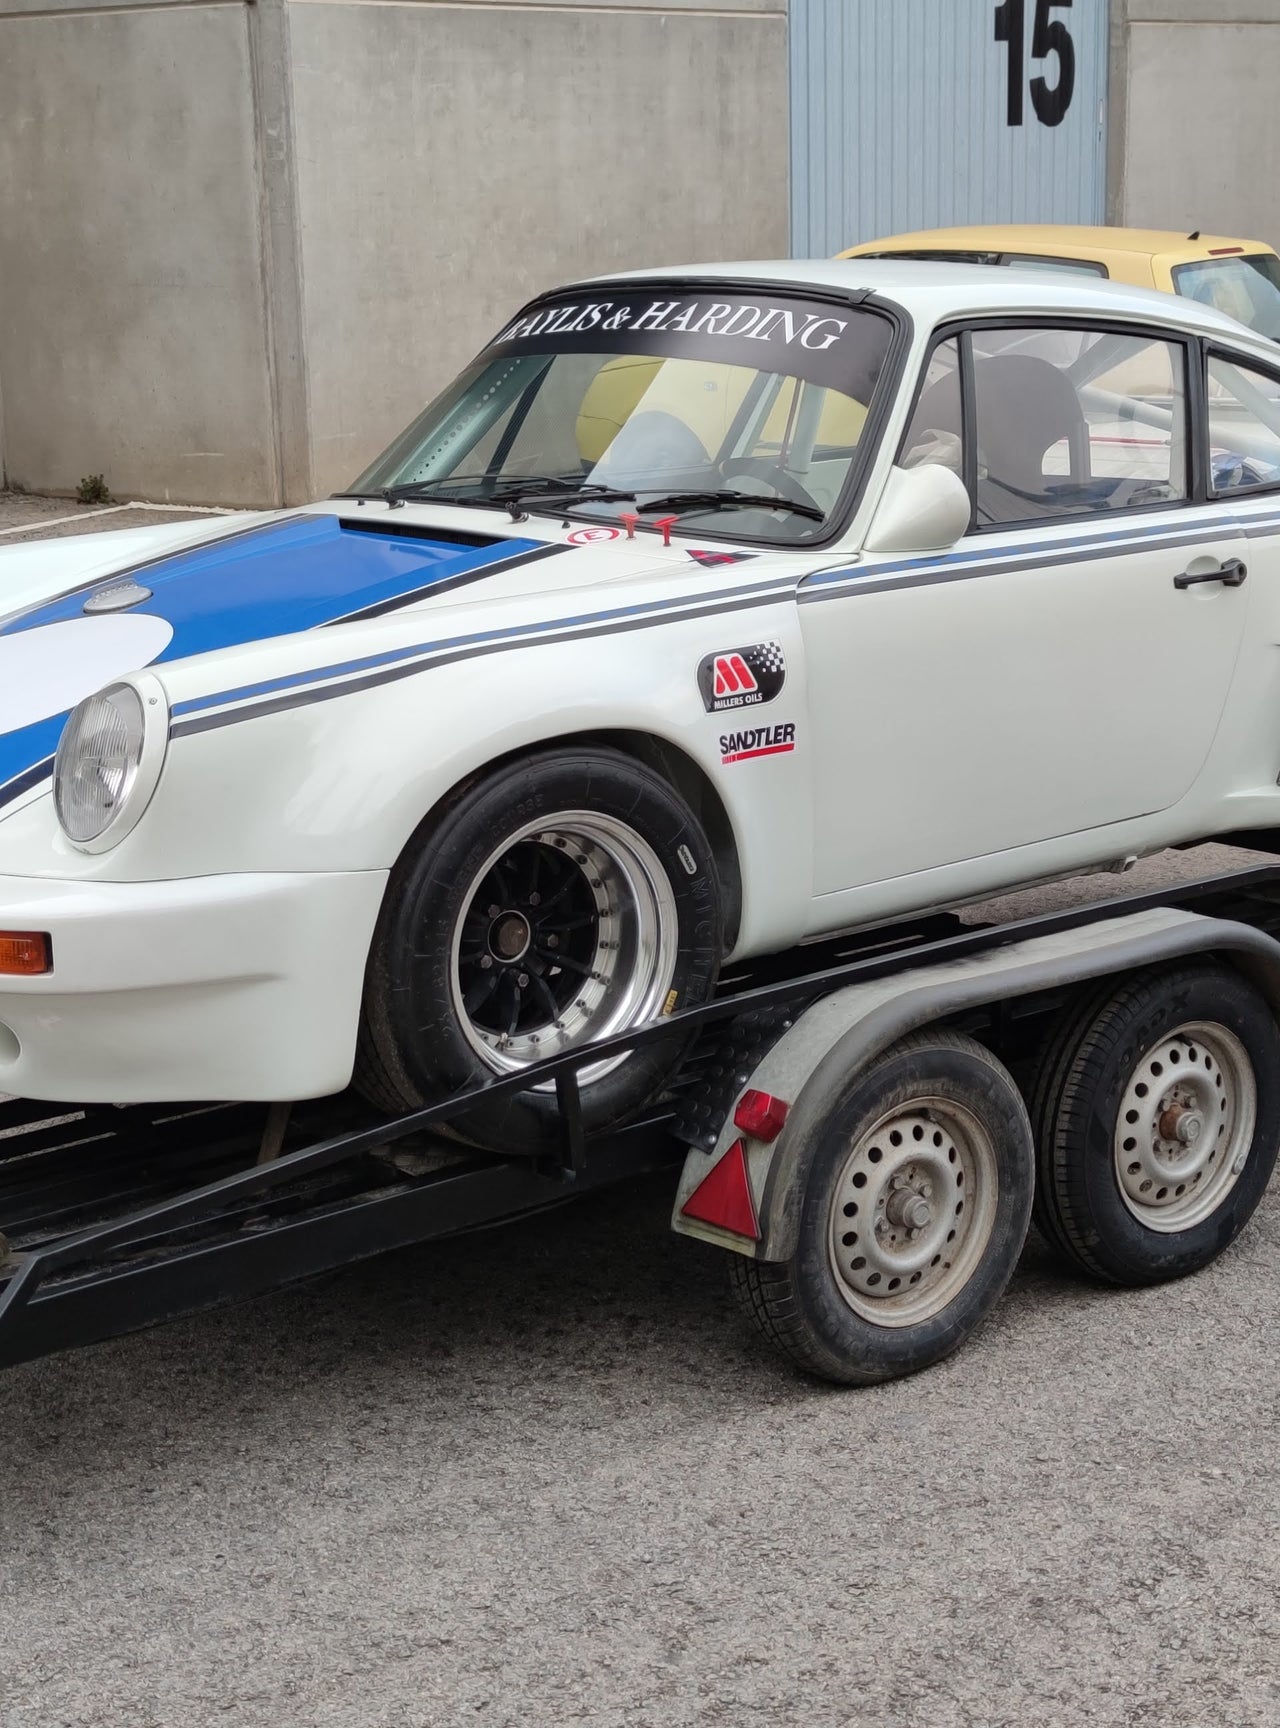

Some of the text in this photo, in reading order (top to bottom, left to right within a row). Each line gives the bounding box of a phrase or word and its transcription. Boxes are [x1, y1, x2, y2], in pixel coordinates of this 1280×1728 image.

[994, 0, 1075, 127] 15
[494, 300, 849, 350] BAYLIS & HARDING
[582, 530, 604, 541] E
[714, 692, 763, 710] MILLERS OILS
[719, 722, 796, 755] SANDTLER
